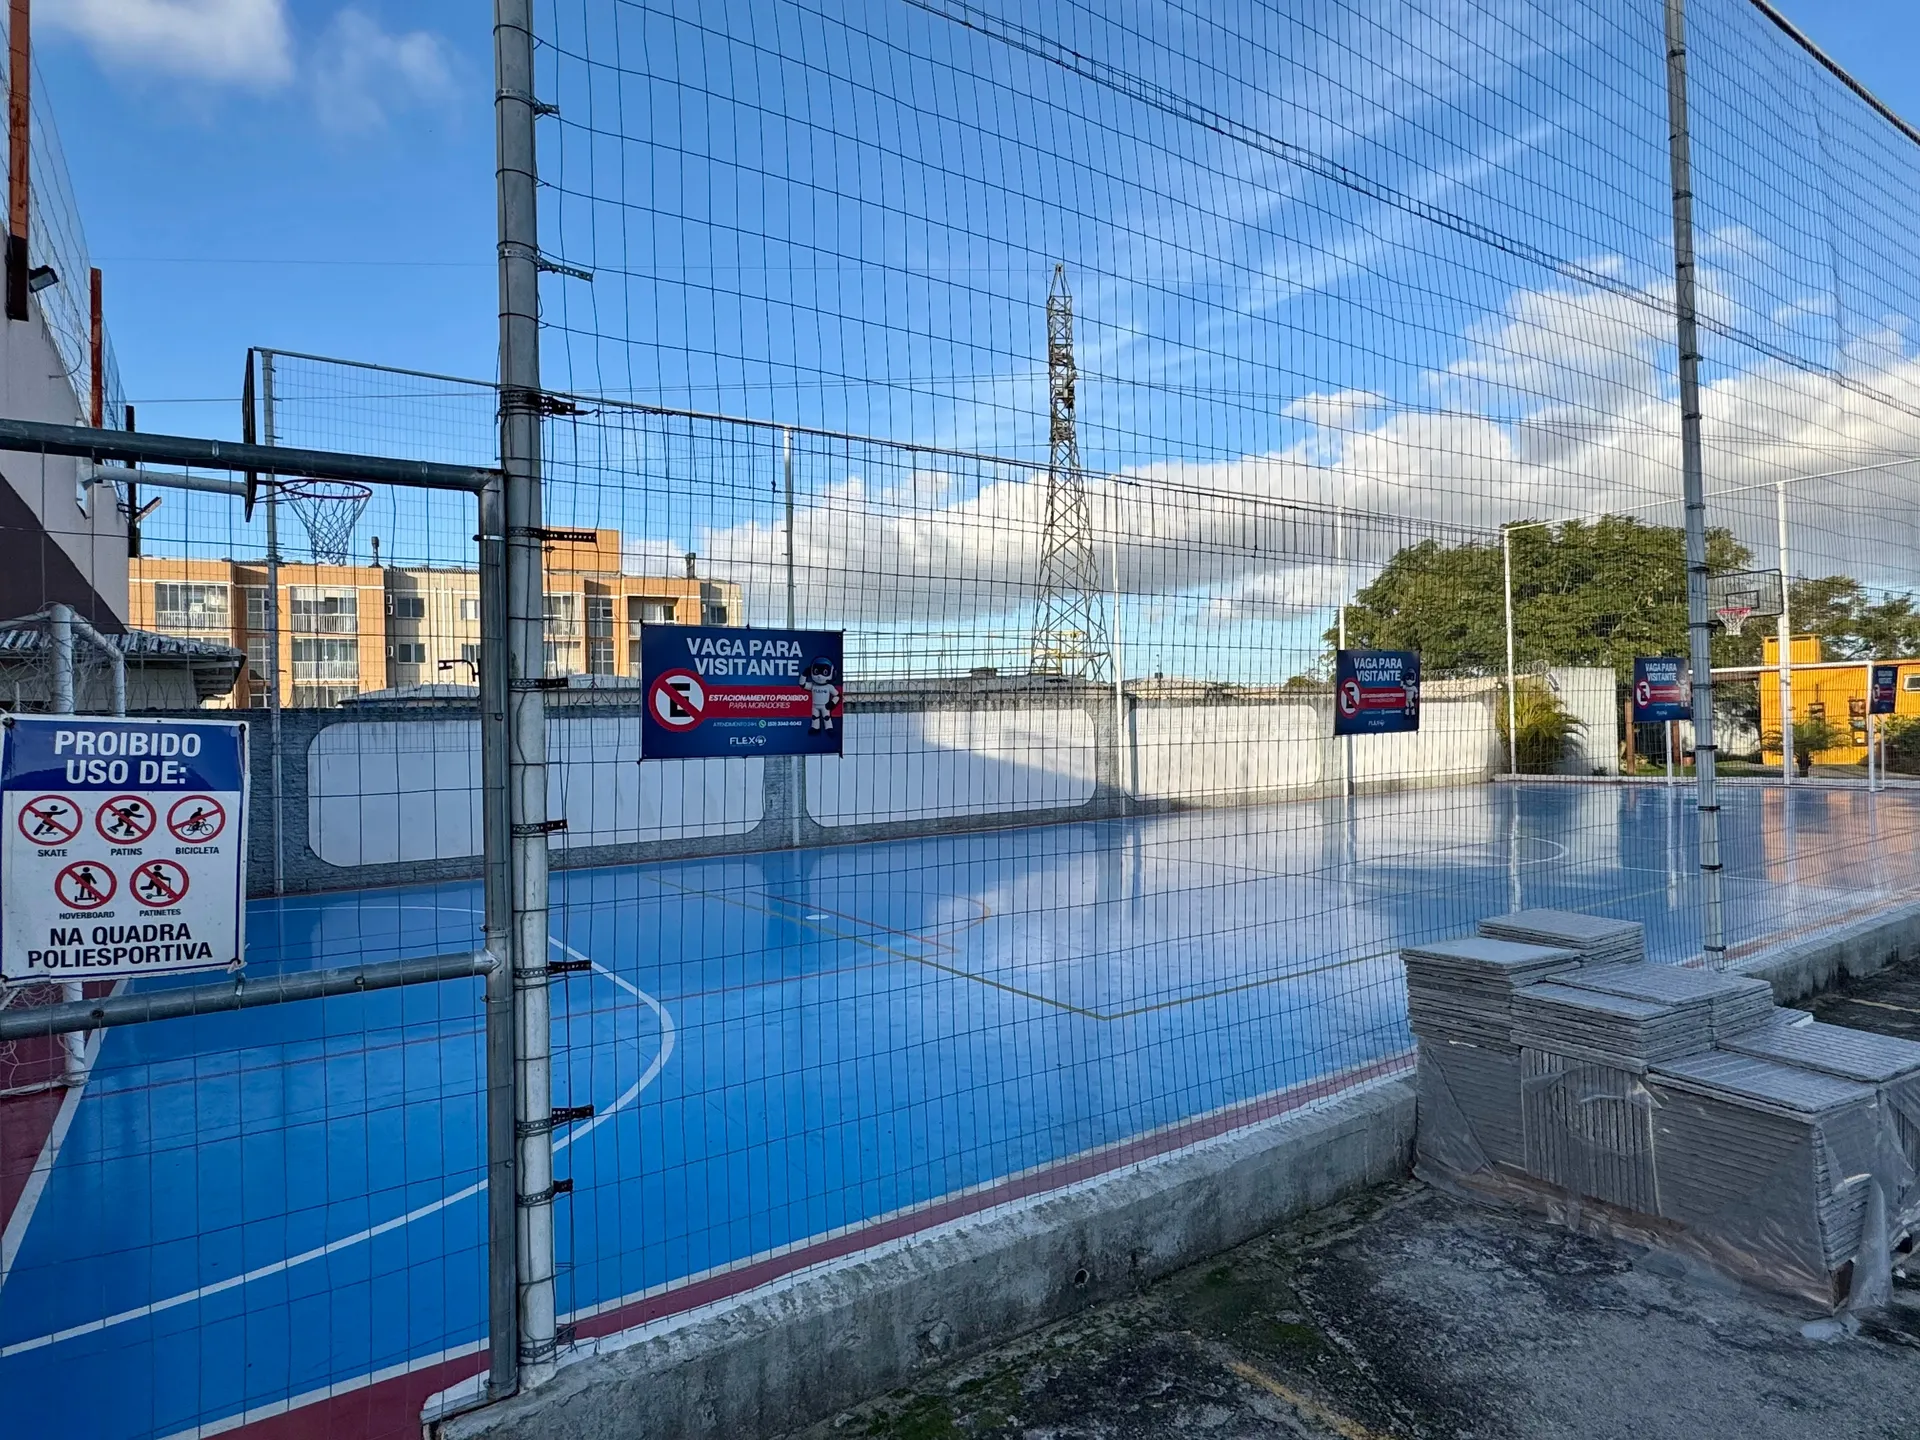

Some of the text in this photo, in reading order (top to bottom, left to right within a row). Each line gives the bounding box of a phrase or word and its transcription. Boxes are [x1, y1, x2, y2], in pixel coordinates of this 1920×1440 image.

[687, 637, 803, 658] VAGA PARA
[694, 657, 800, 676] VISITANTE
[1353, 658, 1403, 669] VAGA PARA
[1356, 670, 1401, 682] VISITANTE
[708, 694, 809, 702] ESTACIONAMENTO PROIBIDO
[54, 731, 202, 757] PROIBIDO
[66, 759, 186, 784] USO DE:
[37, 849, 68, 857] SKATE
[110, 848, 142, 856] PATINS
[175, 846, 219, 855] BICICLETA
[59, 910, 115, 920] HOVERBOARD
[139, 908, 181, 917] PATINETES
[50, 922, 191, 946] NA QUADRA
[28, 942, 213, 968] POLIESPORTIVA
